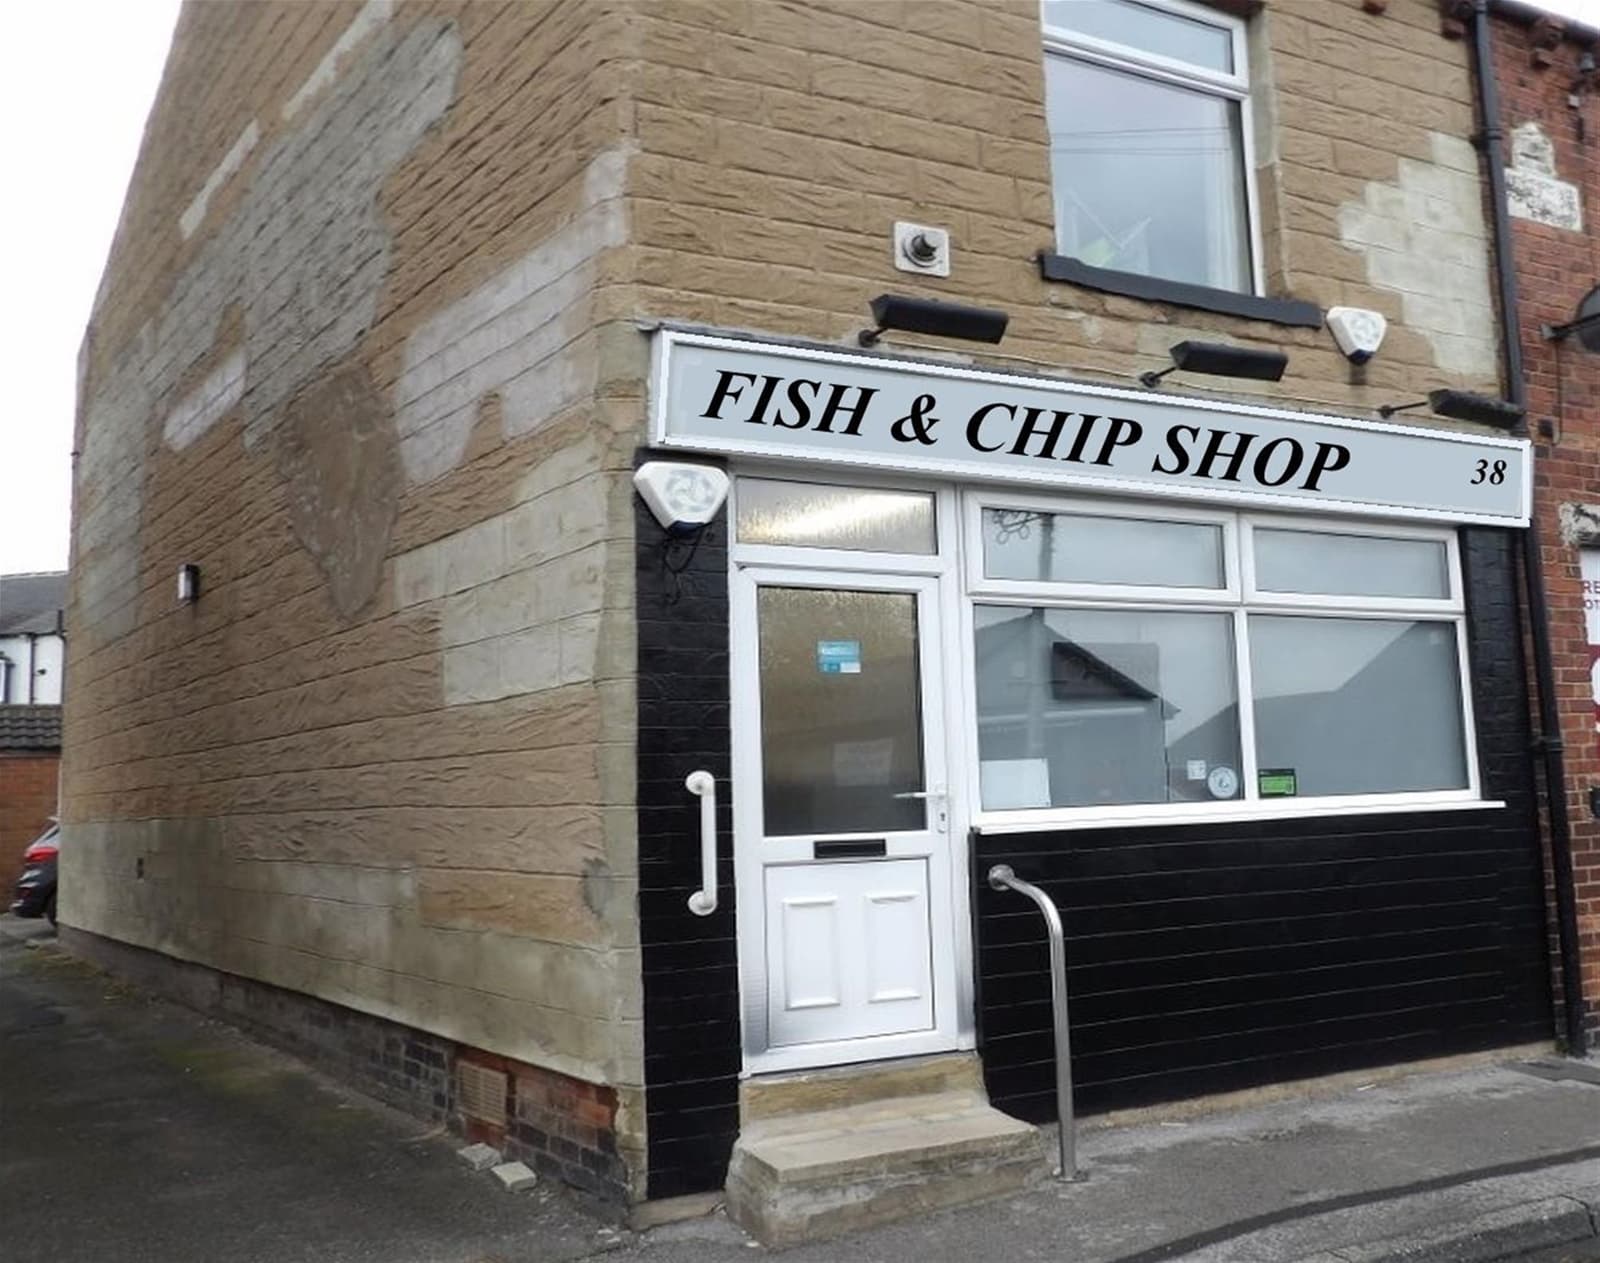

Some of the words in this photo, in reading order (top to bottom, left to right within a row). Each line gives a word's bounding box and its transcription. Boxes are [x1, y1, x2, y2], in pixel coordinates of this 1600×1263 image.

[700, 370, 880, 437] FISH
[890, 394, 940, 446] &
[966, 403, 1143, 467] CHIP
[1151, 424, 1351, 492] SHOP
[1470, 459, 1507, 486] 38
